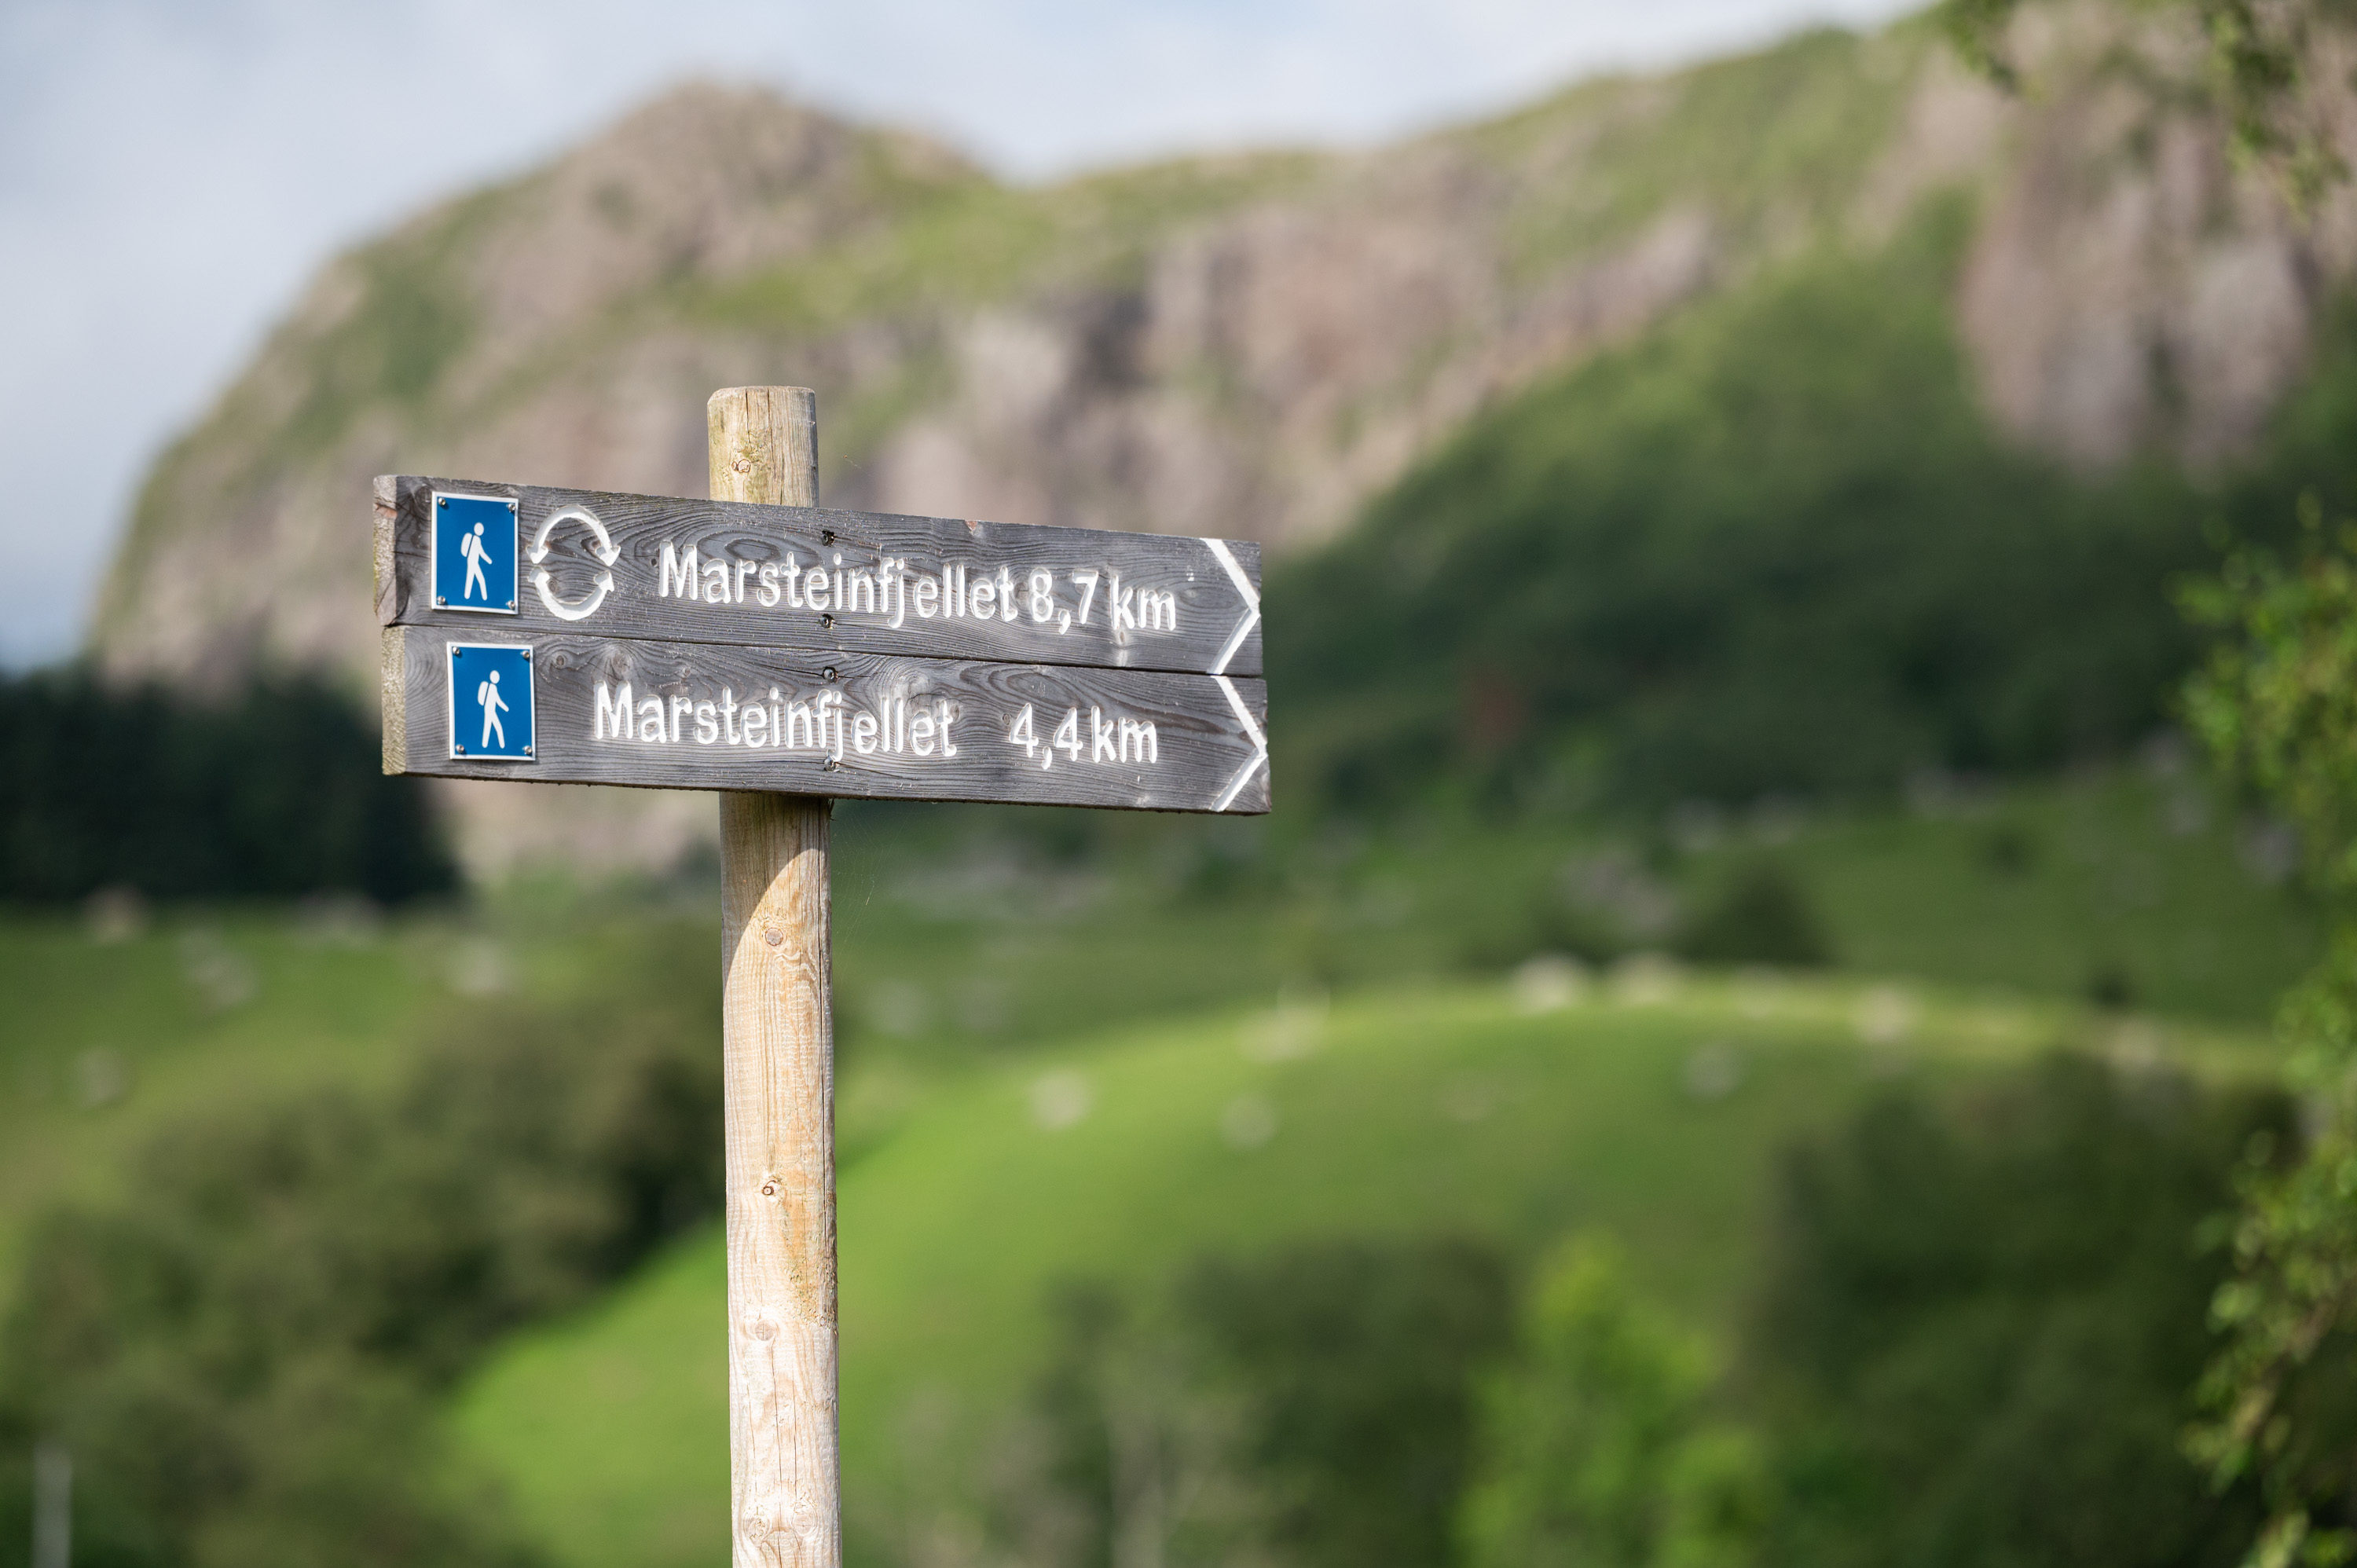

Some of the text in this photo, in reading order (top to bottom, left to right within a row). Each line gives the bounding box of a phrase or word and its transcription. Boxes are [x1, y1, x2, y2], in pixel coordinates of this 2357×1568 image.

[658, 540, 1177, 635] Marsteinfjellet 8,7 km
[593, 680, 958, 762] Marsteinfjellet
